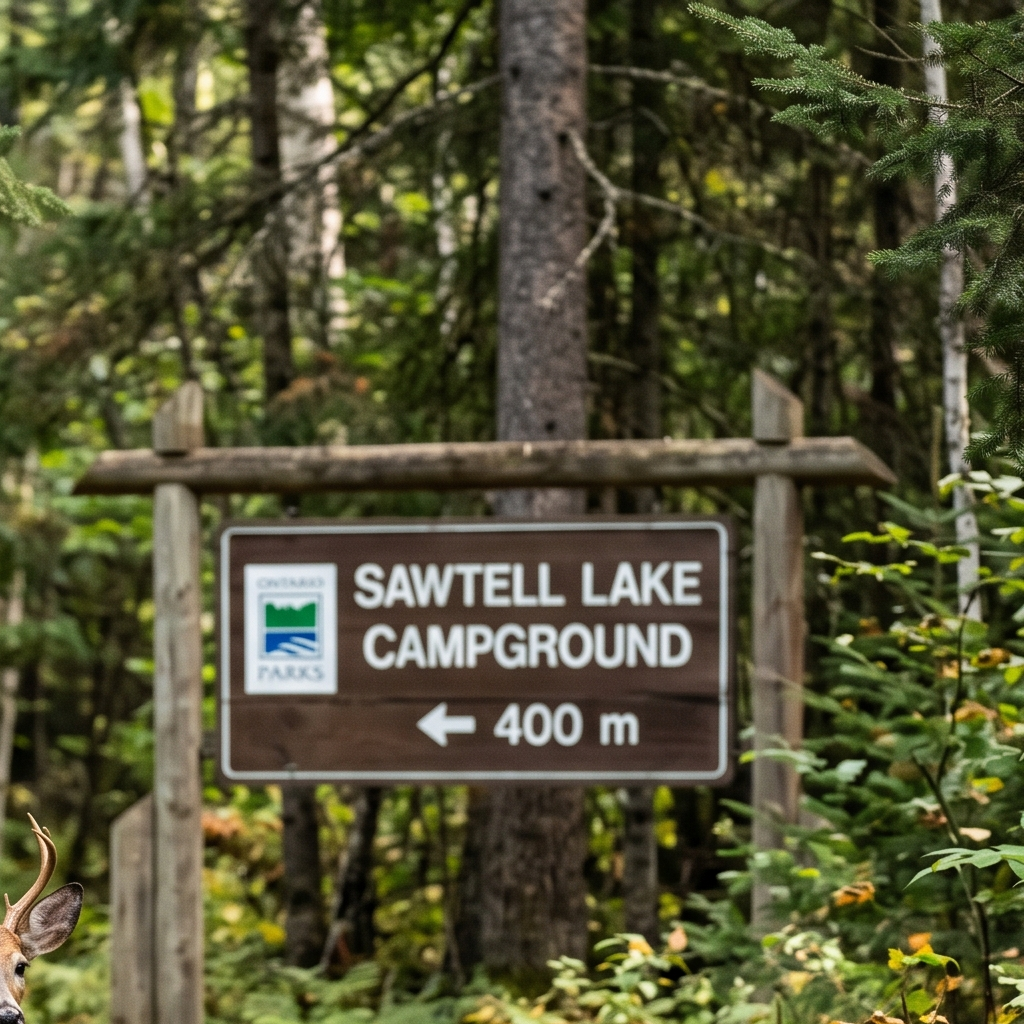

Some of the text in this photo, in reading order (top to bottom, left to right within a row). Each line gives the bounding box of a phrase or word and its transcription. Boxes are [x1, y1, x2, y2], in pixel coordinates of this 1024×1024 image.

[256, 576, 324, 589] ONTARIO
[354, 562, 702, 608] SAWTELL LAKE
[363, 623, 692, 669] CAMPGROUND
[257, 665, 324, 681] PARKS
[494, 704, 638, 746] 400 m
